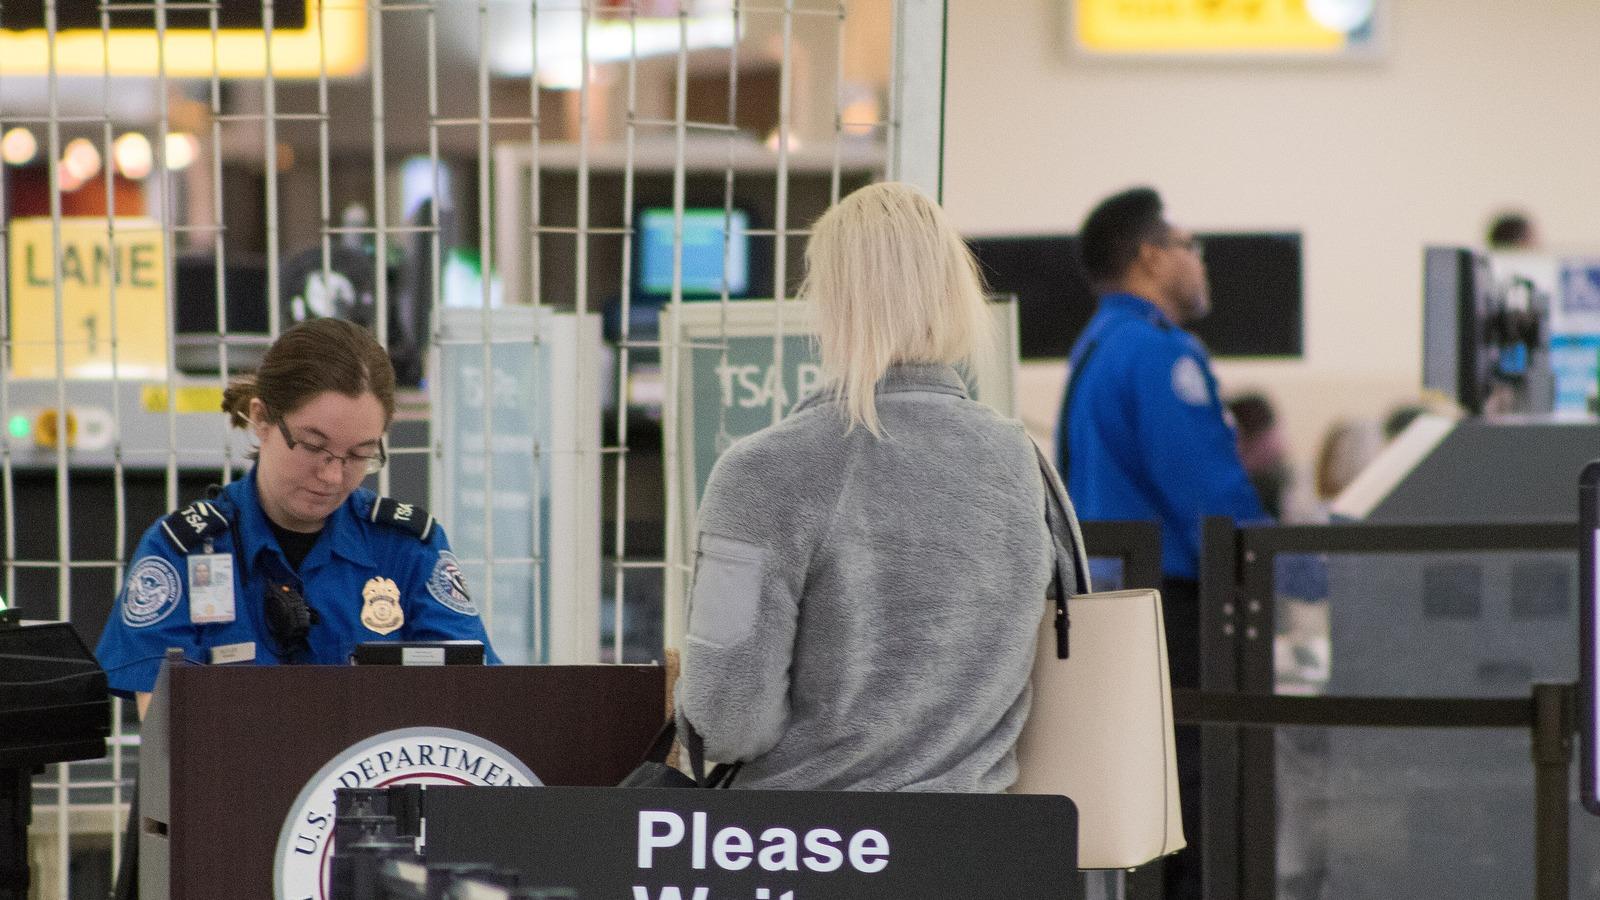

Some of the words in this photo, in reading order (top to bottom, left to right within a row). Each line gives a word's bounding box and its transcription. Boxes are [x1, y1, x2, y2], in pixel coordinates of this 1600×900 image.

[25, 241, 157, 288] LANE
[83, 315, 97, 354] 1
[714, 363, 789, 408] TSA
[181, 505, 208, 534] TSA
[393, 502, 413, 521] TSA
[295, 811, 331, 855] U.S.
[637, 810, 890, 873] Please
